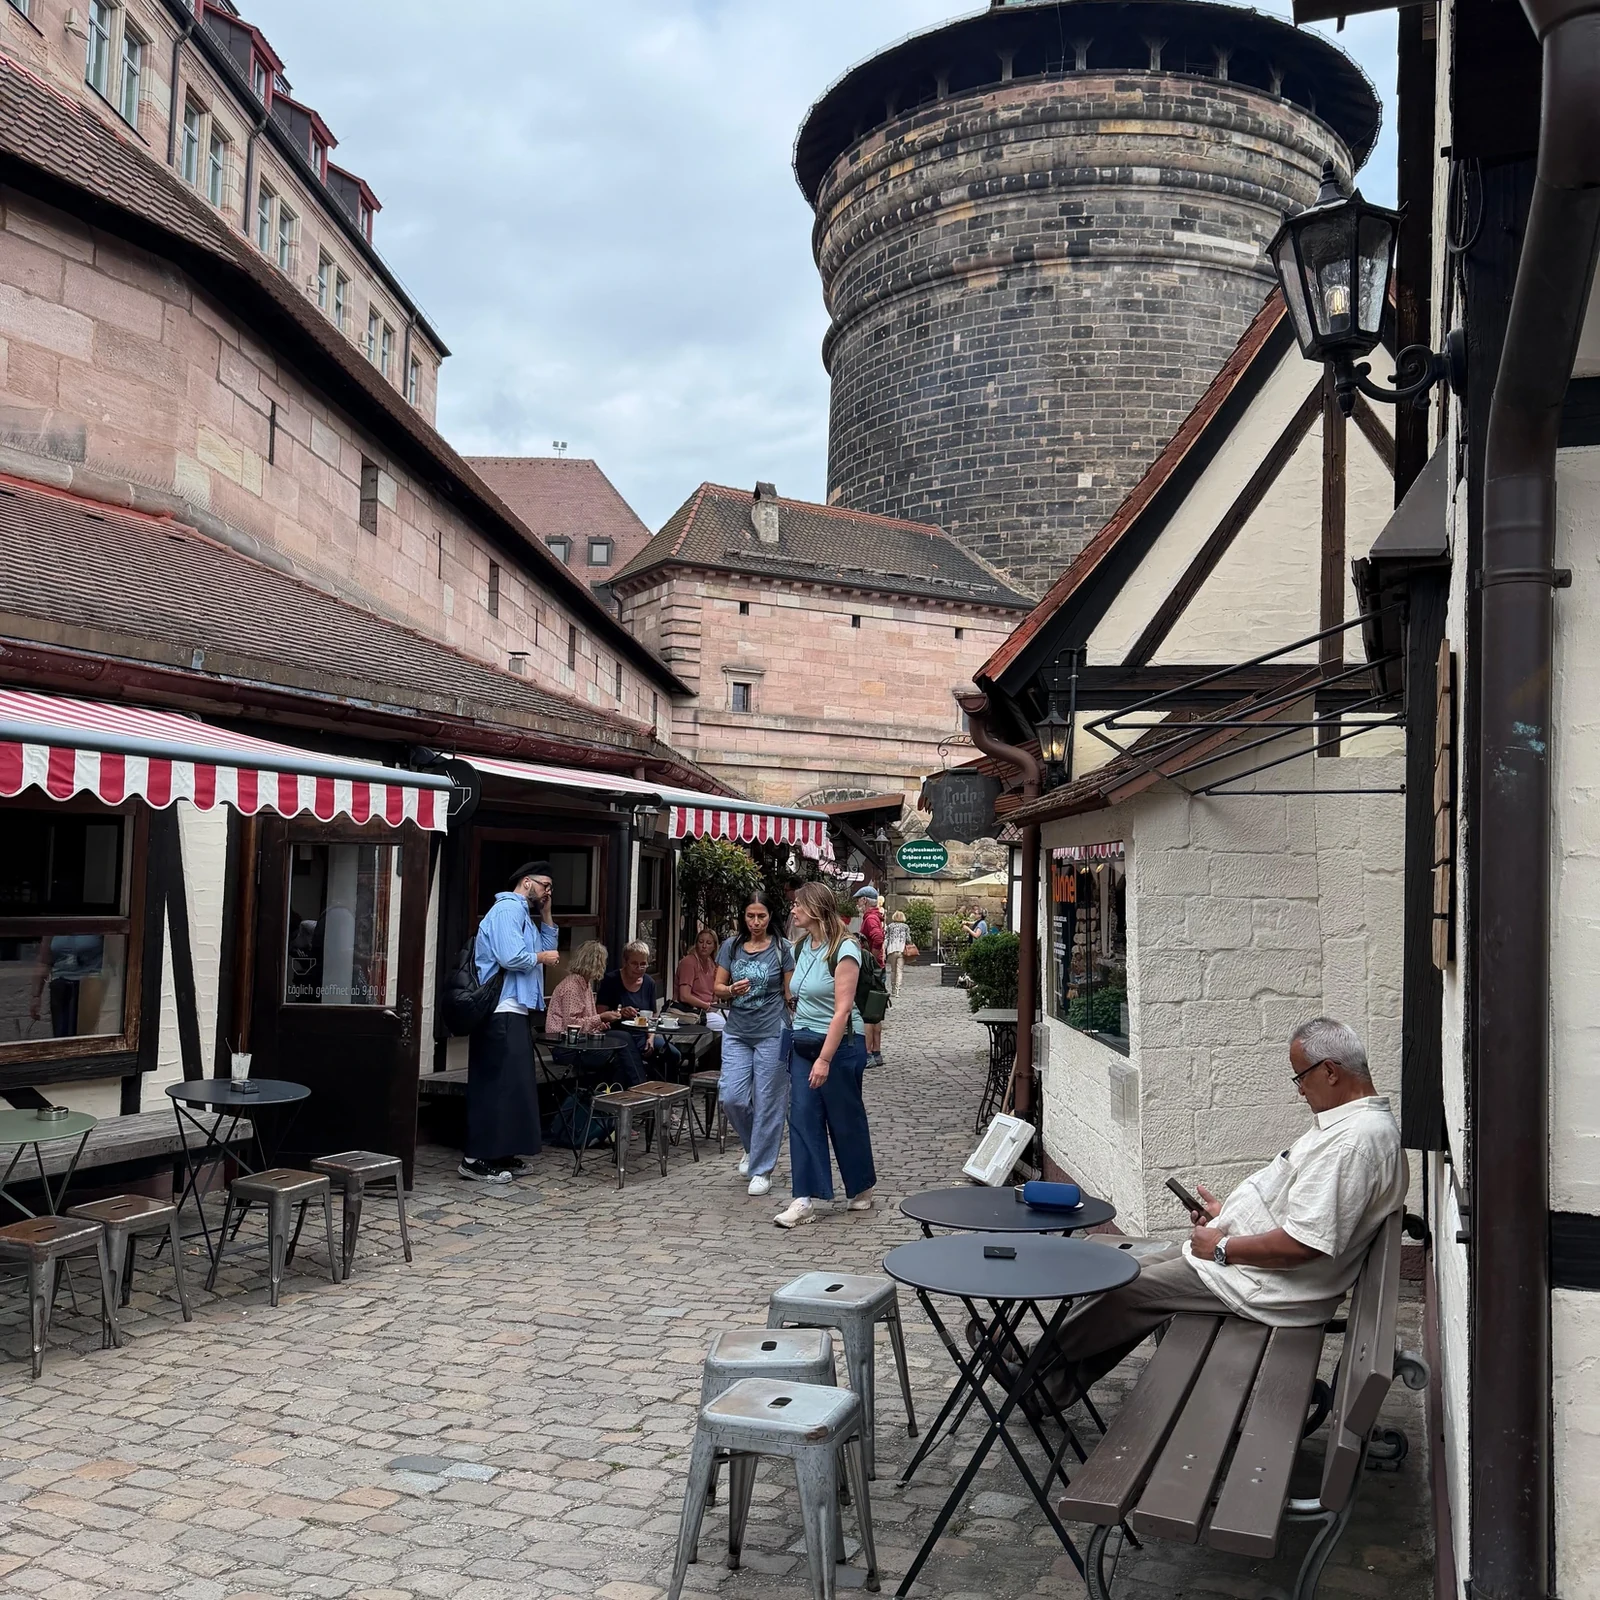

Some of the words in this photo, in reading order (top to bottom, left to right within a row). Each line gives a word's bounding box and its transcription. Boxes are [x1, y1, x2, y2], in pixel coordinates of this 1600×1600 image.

[1051, 862, 1077, 903] Tunnel
[287, 984, 313, 997] täglich
[315, 984, 348, 998] geöffnet
[350, 984, 360, 996] ab
